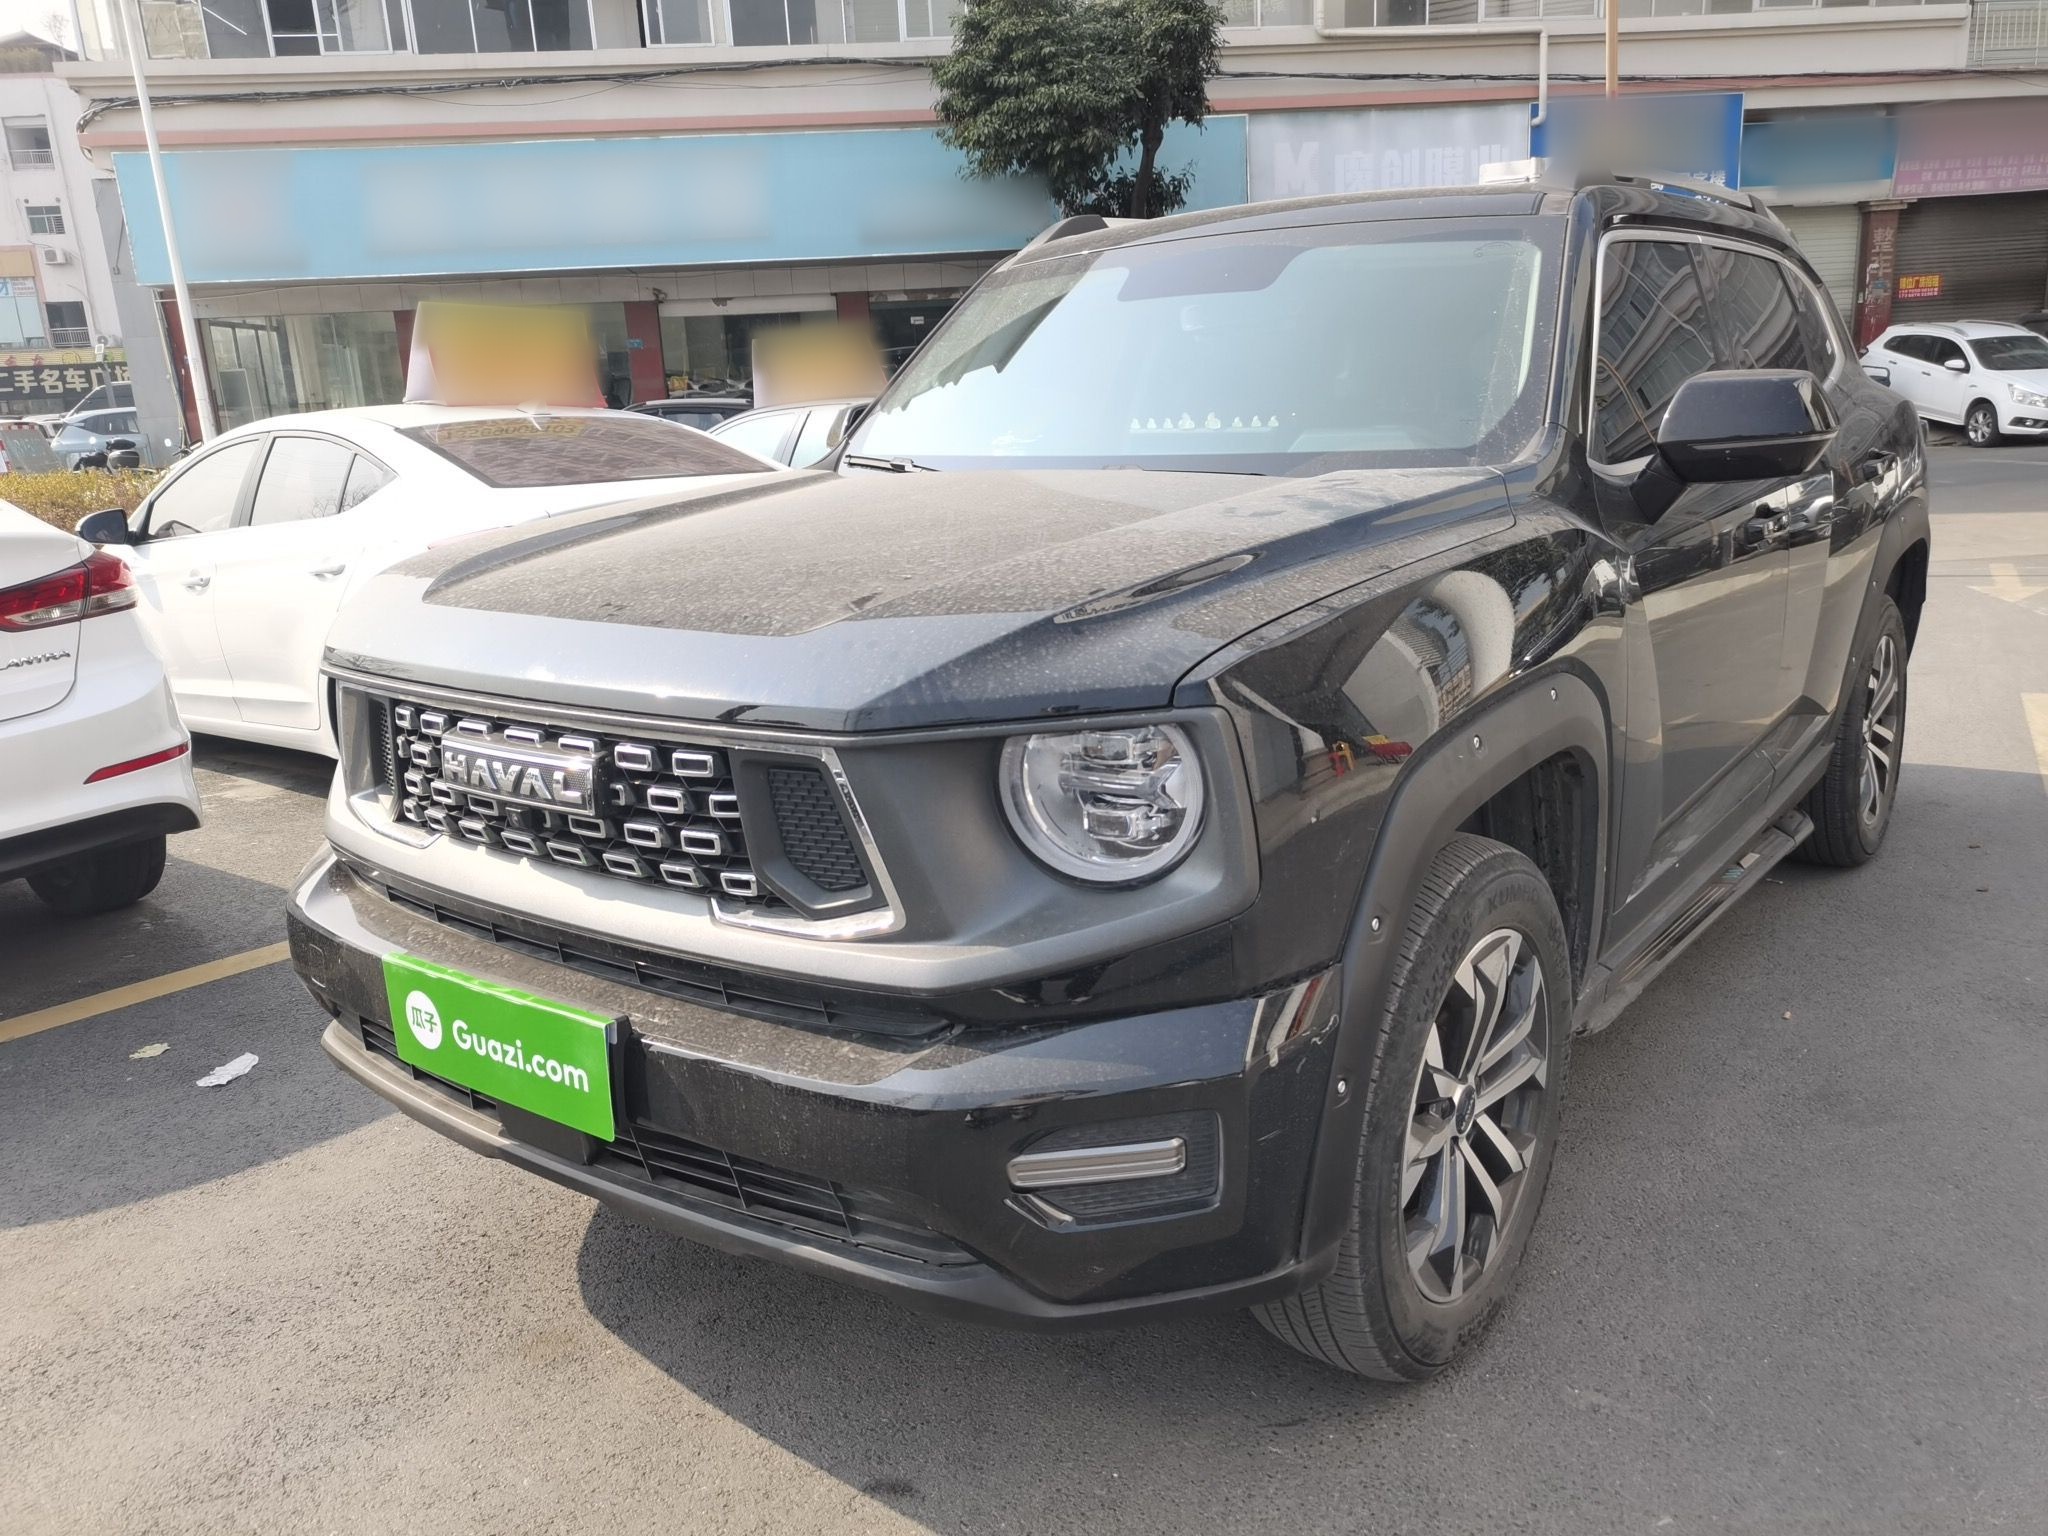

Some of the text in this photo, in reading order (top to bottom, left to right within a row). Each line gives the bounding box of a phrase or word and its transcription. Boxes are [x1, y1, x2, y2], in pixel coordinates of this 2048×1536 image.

[0, 650, 71, 671] ANTRA
[444, 751, 582, 804] HAVAL
[411, 1006, 438, 1033] 瓜子
[452, 1019, 590, 1093] Guazi.com
